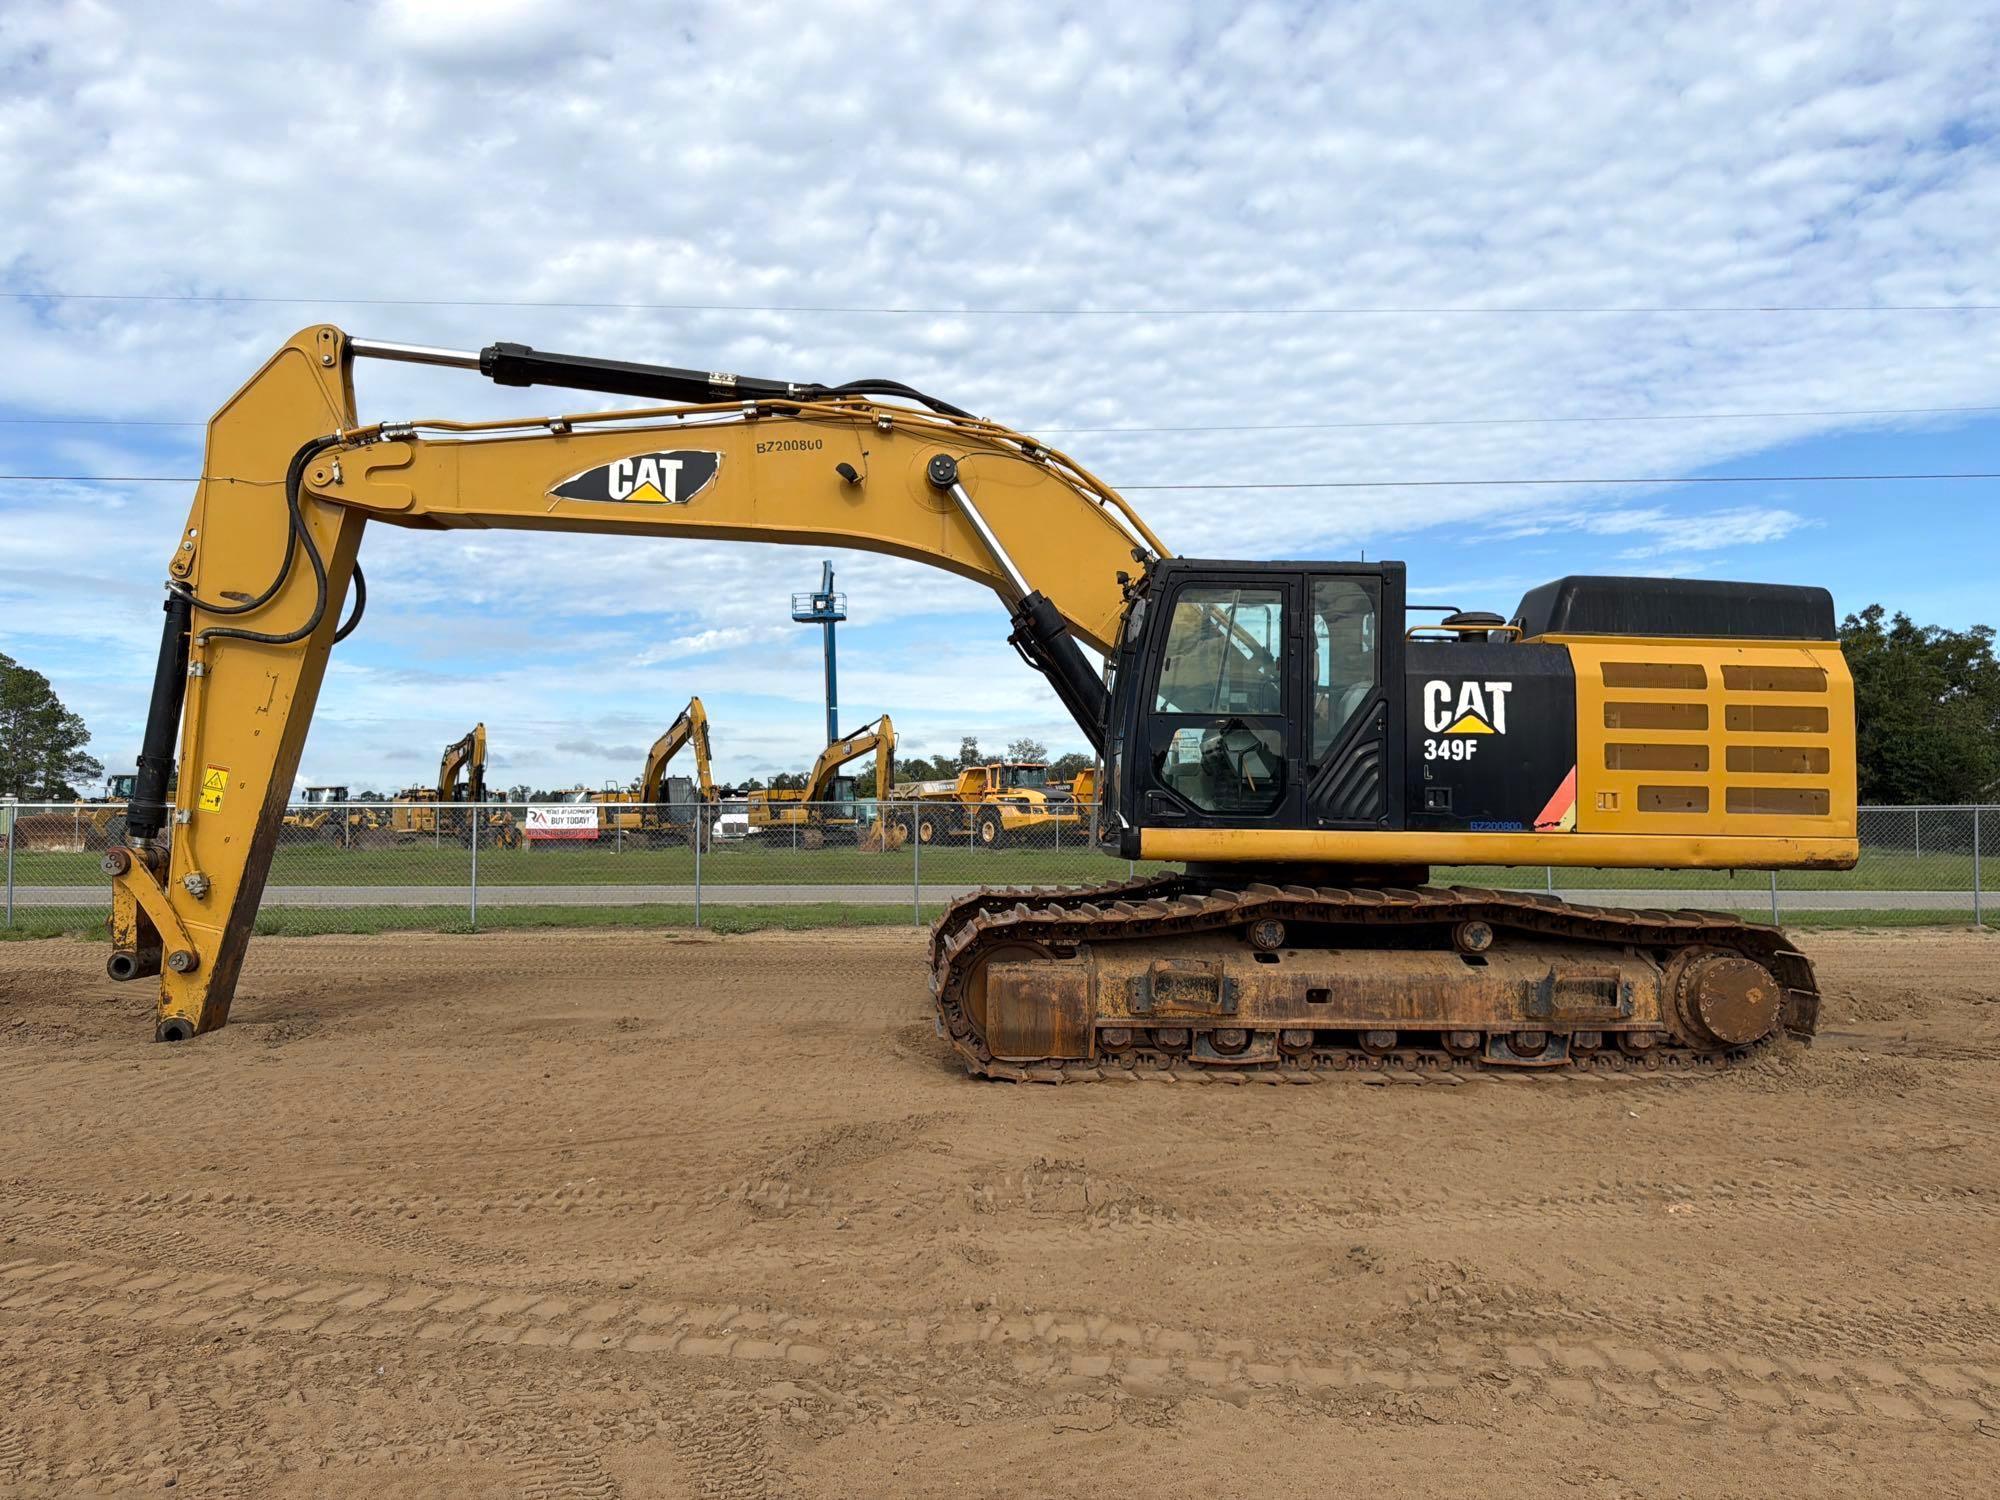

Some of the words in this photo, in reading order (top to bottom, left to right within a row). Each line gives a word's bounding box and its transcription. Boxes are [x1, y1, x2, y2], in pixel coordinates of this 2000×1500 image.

[608, 457, 684, 503] CAT
[1423, 680, 1513, 735] CAT
[1424, 738, 1478, 761] 349F
[551, 816, 564, 825] BUY
[566, 816, 590, 825] TODAY!
